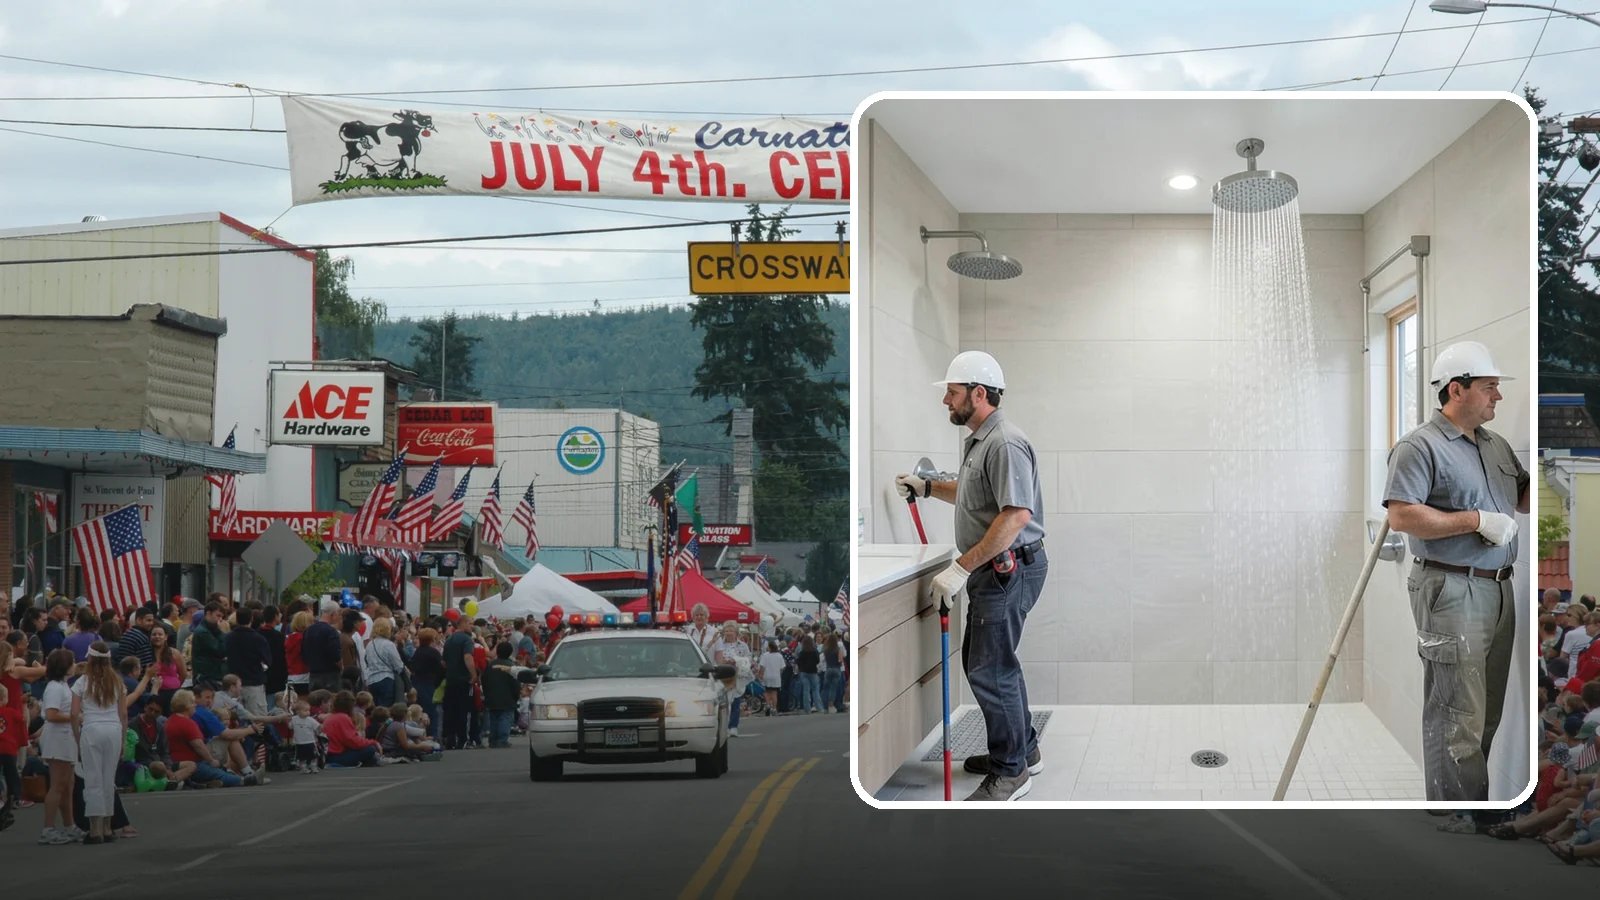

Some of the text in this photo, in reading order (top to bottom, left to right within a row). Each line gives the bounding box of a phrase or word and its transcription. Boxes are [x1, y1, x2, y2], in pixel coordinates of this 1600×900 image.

[481, 141, 605, 192] JULY
[632, 150, 746, 198] 4th.
[697, 254, 850, 280] CROSSWA
[283, 380, 373, 420] ACE
[405, 409, 452, 421] CEDAR
[283, 421, 371, 436] Hardware
[95, 485, 125, 495] Vincent
[126, 485, 136, 495] de
[137, 485, 155, 495] Paul
[688, 526, 742, 535] CRNATION
